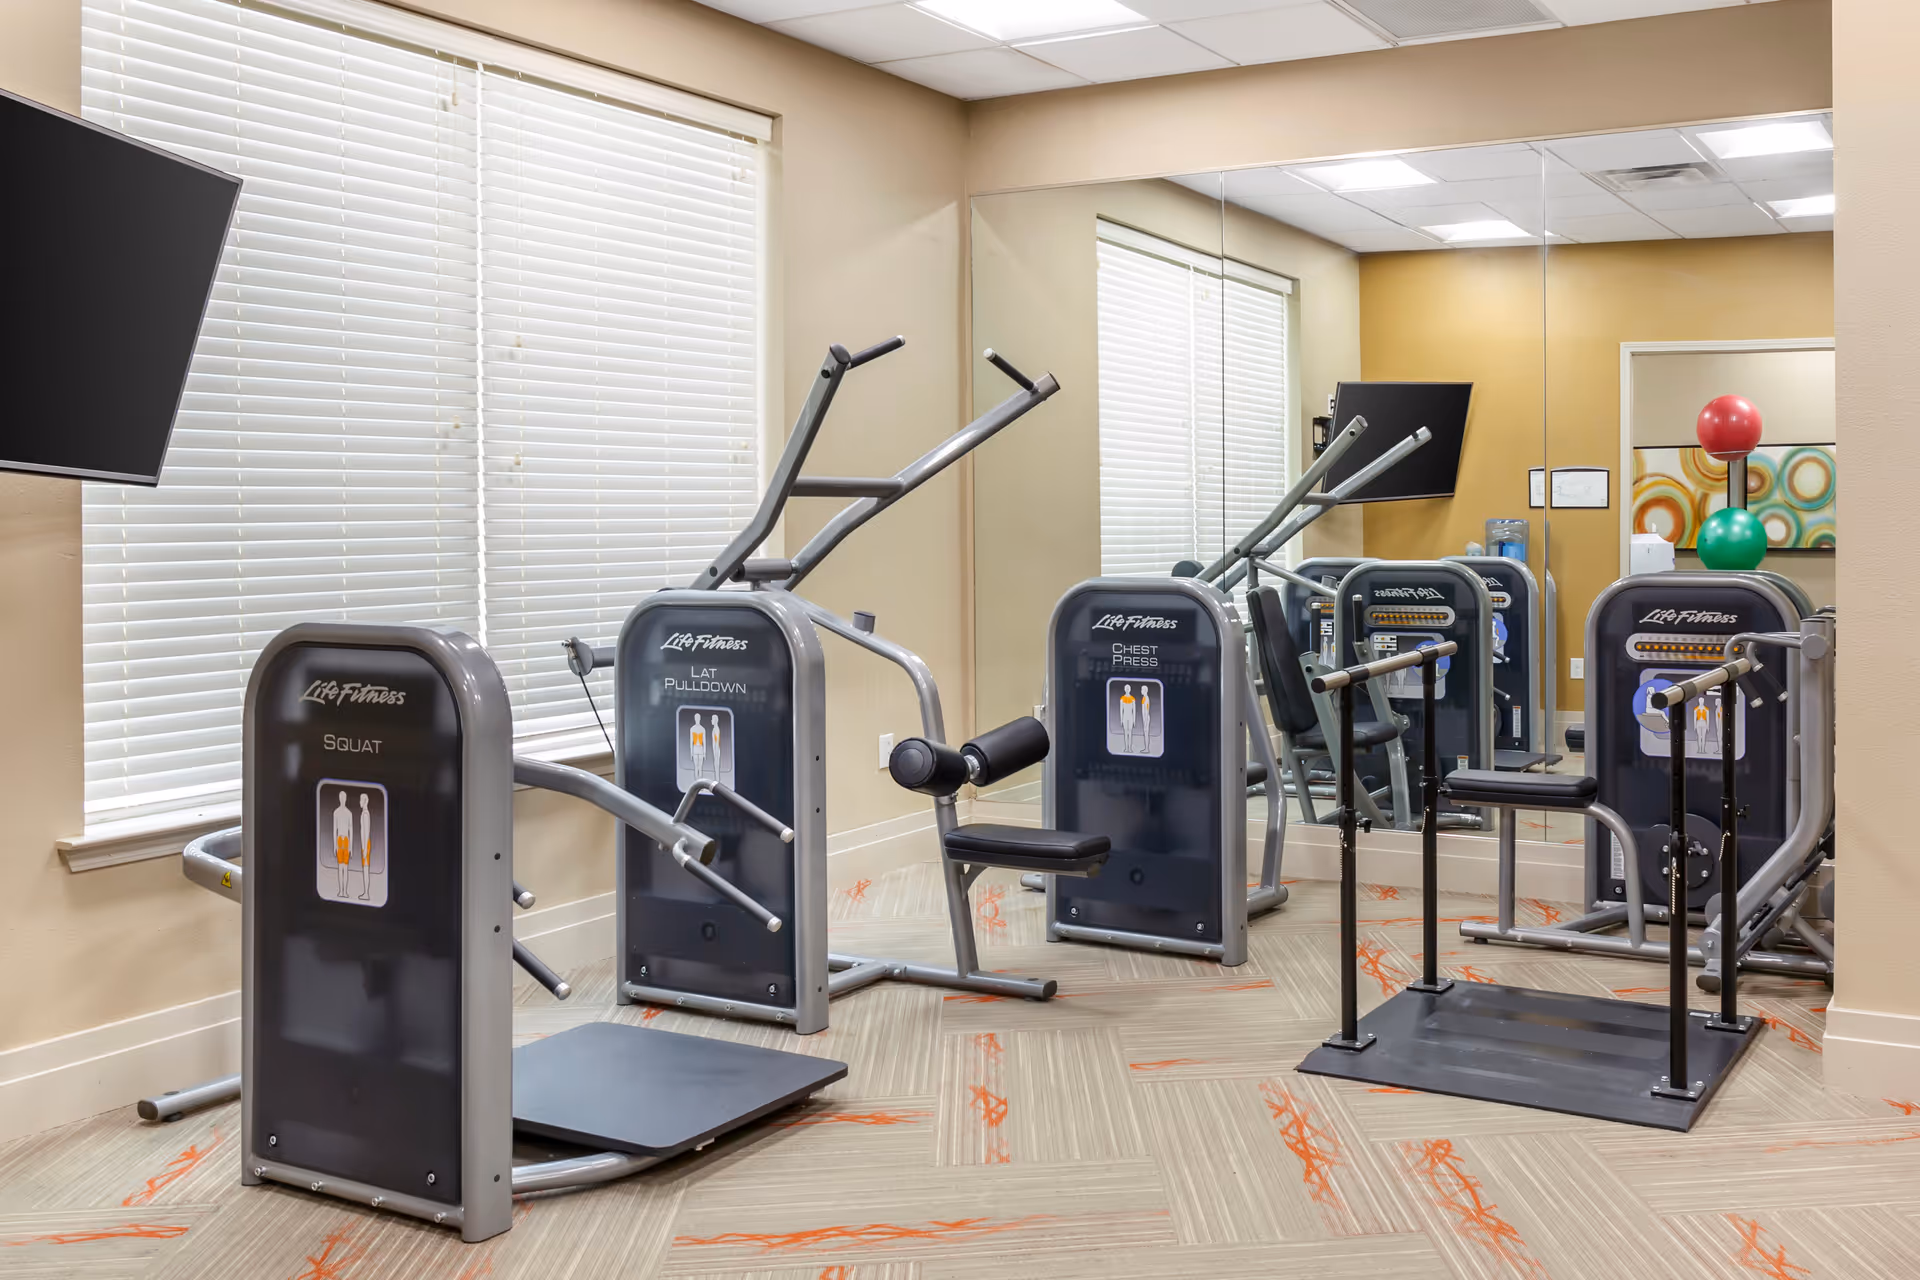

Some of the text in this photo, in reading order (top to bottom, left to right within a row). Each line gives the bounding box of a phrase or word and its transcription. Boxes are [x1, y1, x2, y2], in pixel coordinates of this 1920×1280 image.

[1112, 642, 1158, 655] CHEST
[1112, 654, 1158, 667] PRESS
[691, 665, 717, 679] LAT
[664, 677, 747, 694] PULLDOWN
[323, 734, 383, 754] SQUAT
